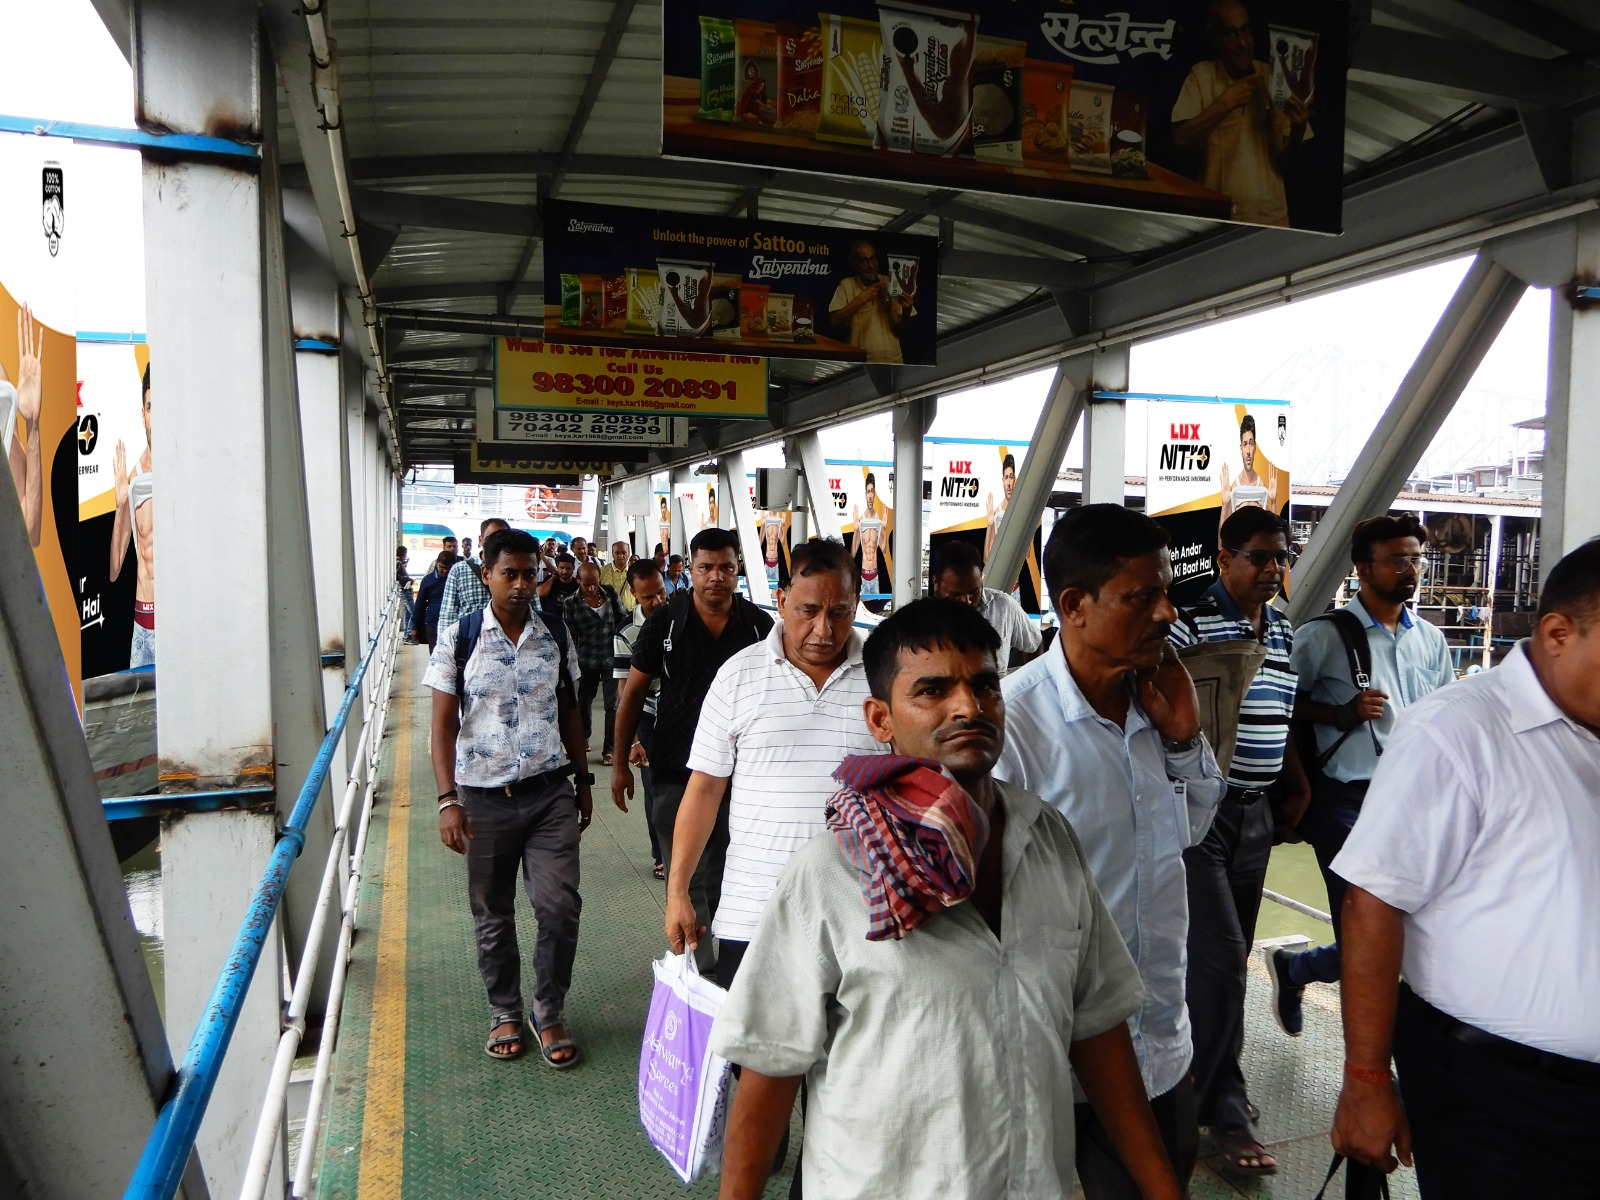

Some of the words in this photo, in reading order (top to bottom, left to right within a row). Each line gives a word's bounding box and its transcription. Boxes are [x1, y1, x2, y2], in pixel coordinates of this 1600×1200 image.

[1040, 12, 1176, 64] सत्येन्द्र
[707, 50, 735, 65] Satyend
[787, 88, 820, 107] Dalia
[830, 103, 868, 118] sattoo
[567, 218, 614, 234] Satyendra
[652, 229, 686, 243] Unlock
[688, 232, 705, 245] the
[706, 237, 737, 249] power
[738, 237, 749, 248] of
[753, 232, 806, 254] Sattoo
[808, 244, 829, 256] with
[749, 255, 832, 279] Satyendra
[506, 337, 544, 353] Want
[607, 362, 638, 373] Call
[644, 364, 664, 375] Us
[532, 371, 635, 397] 98300
[643, 377, 737, 400] 20891
[576, 397, 600, 406] E-mail
[509, 412, 584, 423] 98300
[592, 414, 660, 426] 20891
[508, 422, 582, 433] 70442
[590, 425, 661, 435] 85299
[1170, 423, 1201, 440] LUX
[78, 464, 99, 476] ERWEAR
[949, 461, 972, 474] LUX
[829, 479, 841, 490] UX
[1180, 542, 1203, 559] Andar
[1173, 562, 1182, 578] Ki
[1182, 559, 1199, 576] Baat
[1199, 555, 1212, 571] Hai
[82, 593, 101, 620] Hai
[647, 1058, 679, 1096] Sarees
